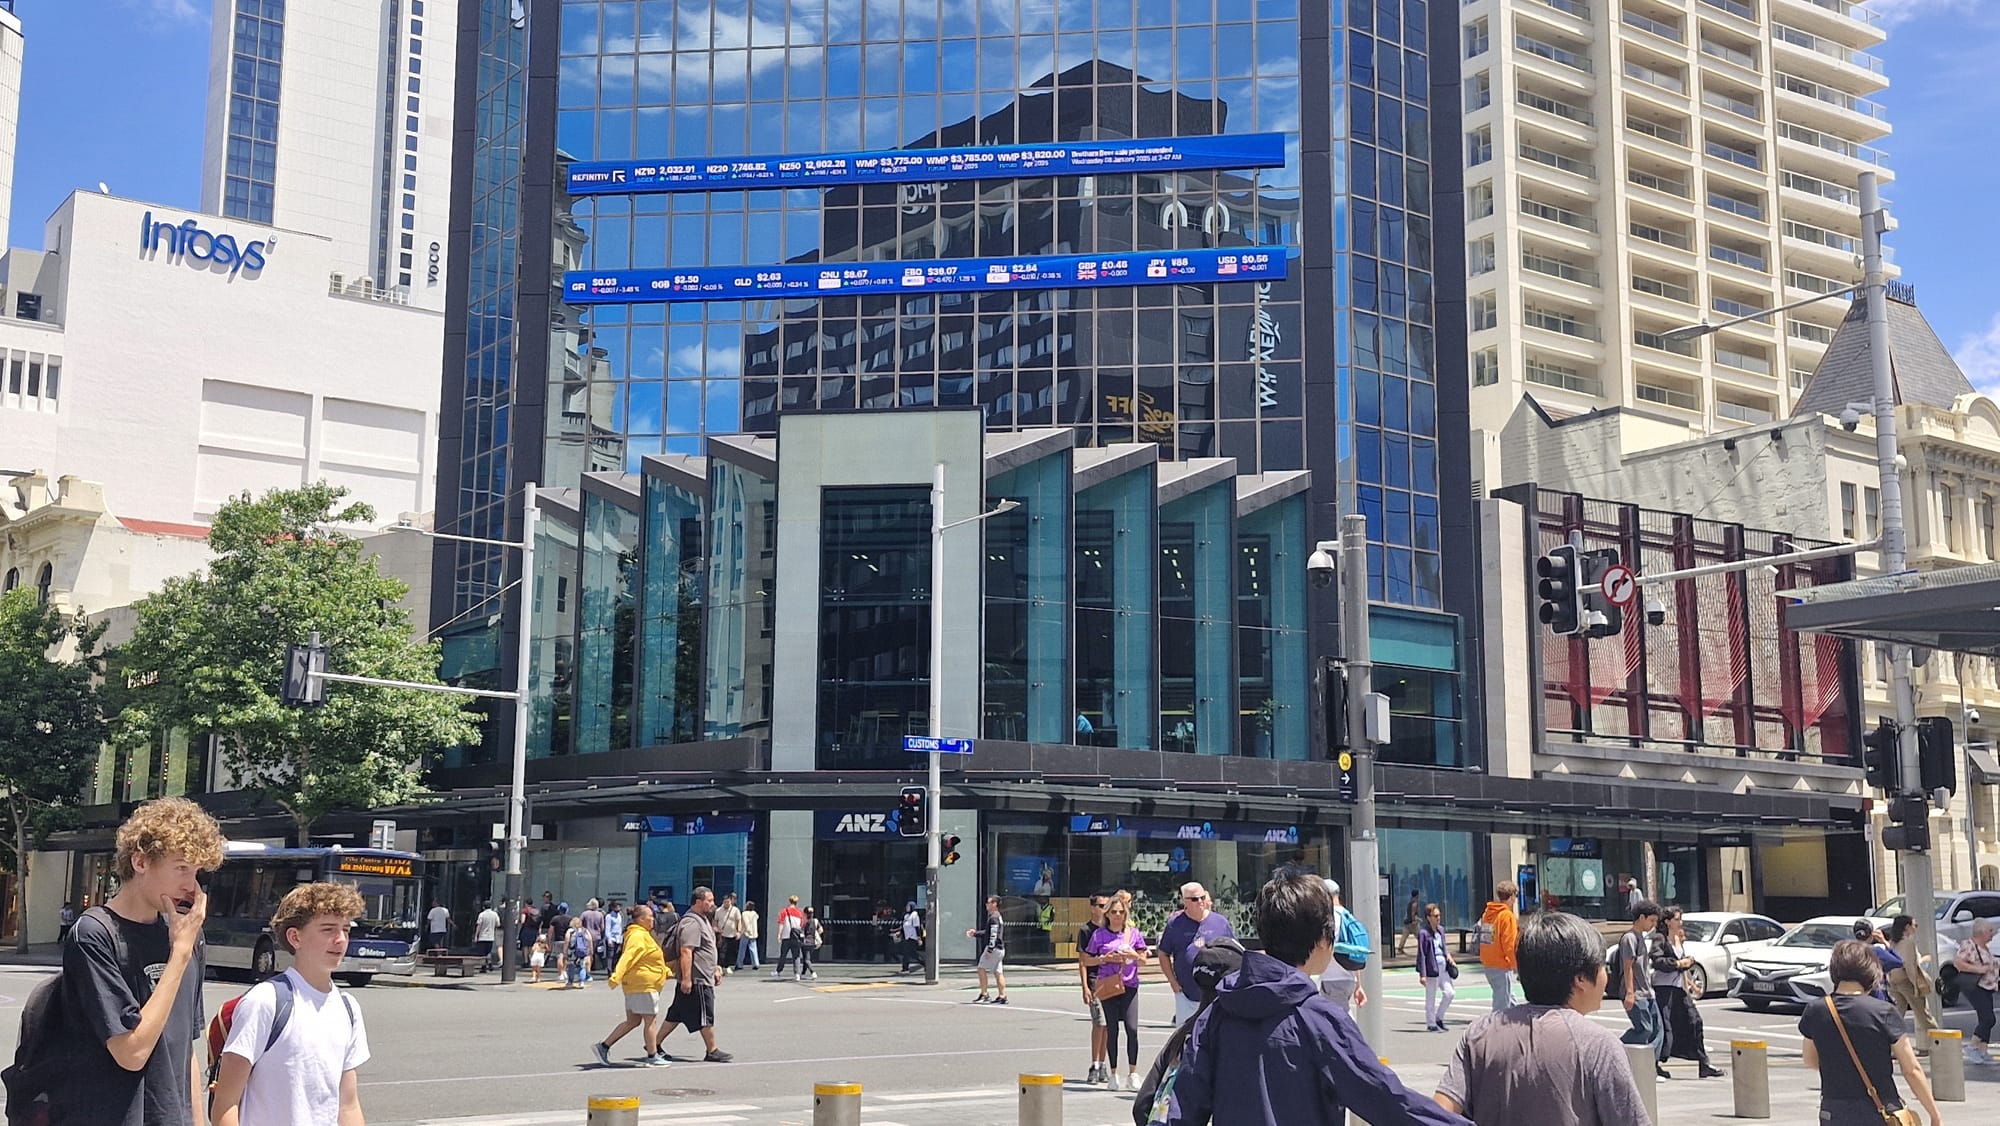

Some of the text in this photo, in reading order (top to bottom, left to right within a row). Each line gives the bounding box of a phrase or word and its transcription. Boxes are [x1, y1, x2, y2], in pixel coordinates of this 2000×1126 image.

[926, 156, 948, 164] WMP
[997, 153, 1020, 161] WMP
[706, 165, 728, 173] NZ20
[779, 162, 801, 170] NZ50
[634, 168, 656, 176] NZ10
[572, 173, 609, 181] REFINITIV
[143, 212, 265, 273] Infosys
[1149, 259, 1165, 267] JPY
[1218, 256, 1237, 264] USD
[1078, 262, 1097, 270] GBP
[820, 271, 839, 279] CNU
[592, 278, 617, 286] $0.03
[674, 275, 699, 284] $2.50
[908, 738, 939, 750] CUSTOMS
[624, 822, 640, 830] ANZ
[835, 814, 885, 832] ANZ
[1090, 822, 1102, 830] ANZ
[1177, 826, 1201, 838] ANZ
[1264, 830, 1288, 842] ANZ
[1131, 853, 1170, 872] ANZ
[366, 948, 385, 956] Metro
